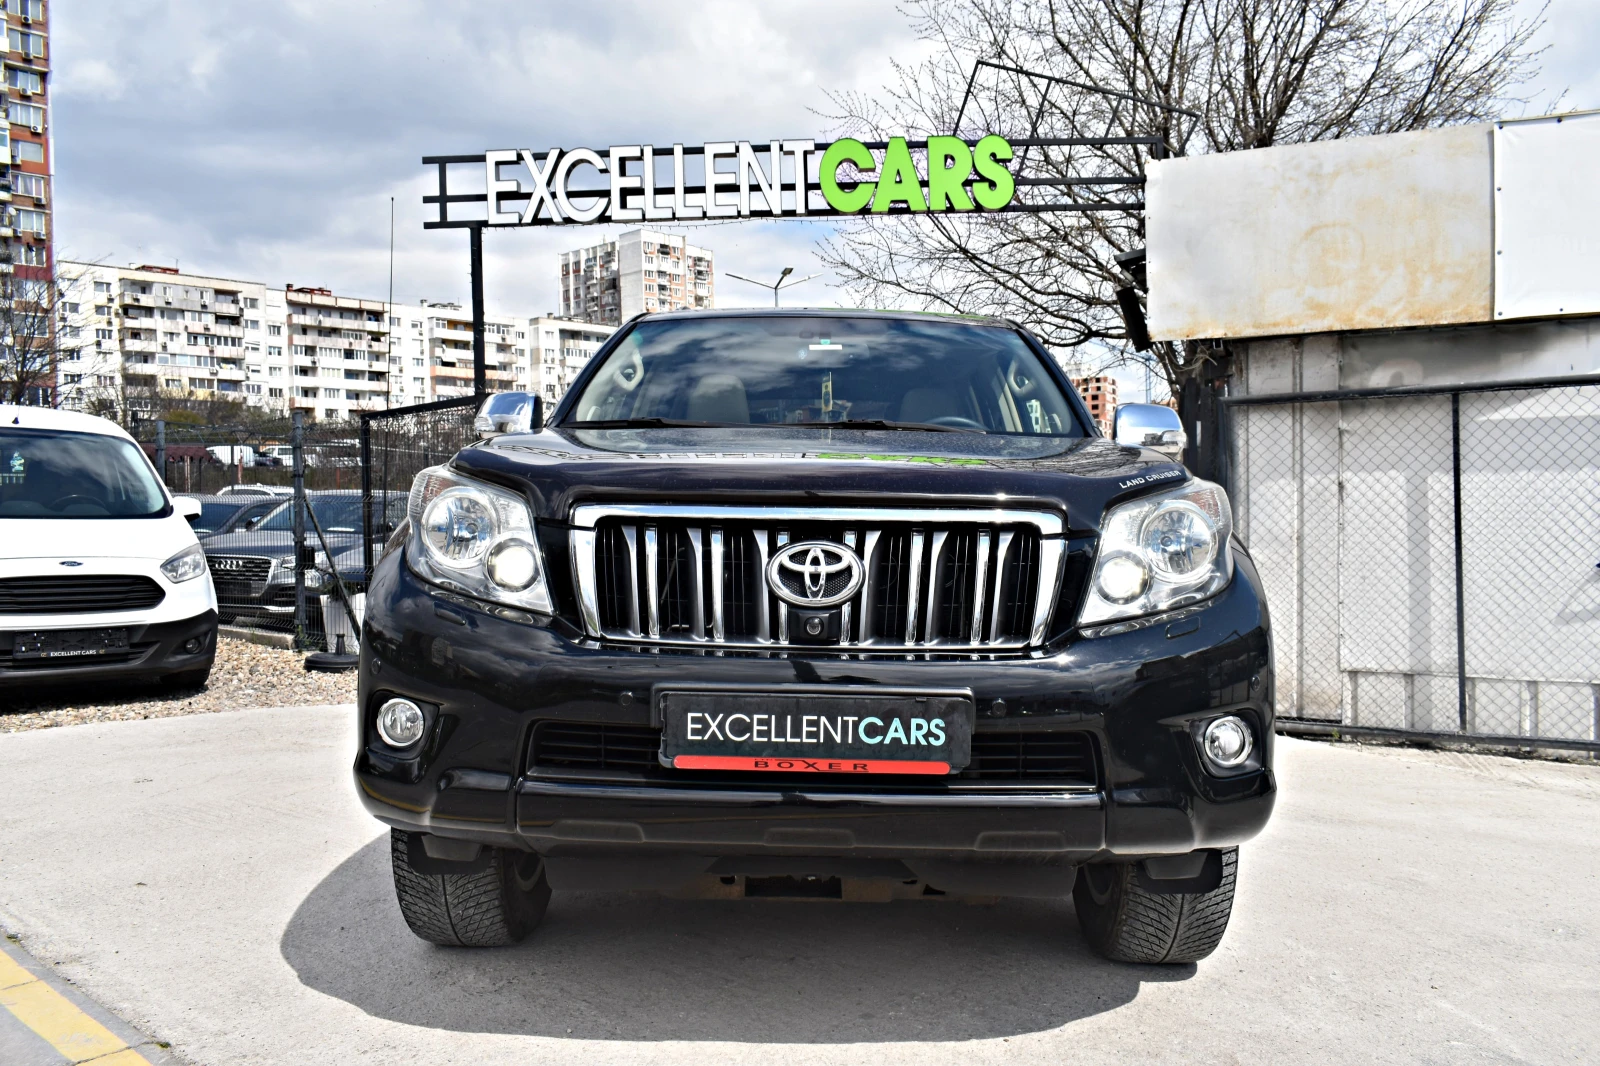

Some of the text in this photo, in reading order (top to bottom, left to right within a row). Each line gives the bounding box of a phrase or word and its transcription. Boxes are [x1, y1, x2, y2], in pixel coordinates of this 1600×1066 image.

[1118, 470, 1182, 489] LAND CRUISER
[754, 760, 869, 772] BOXER
